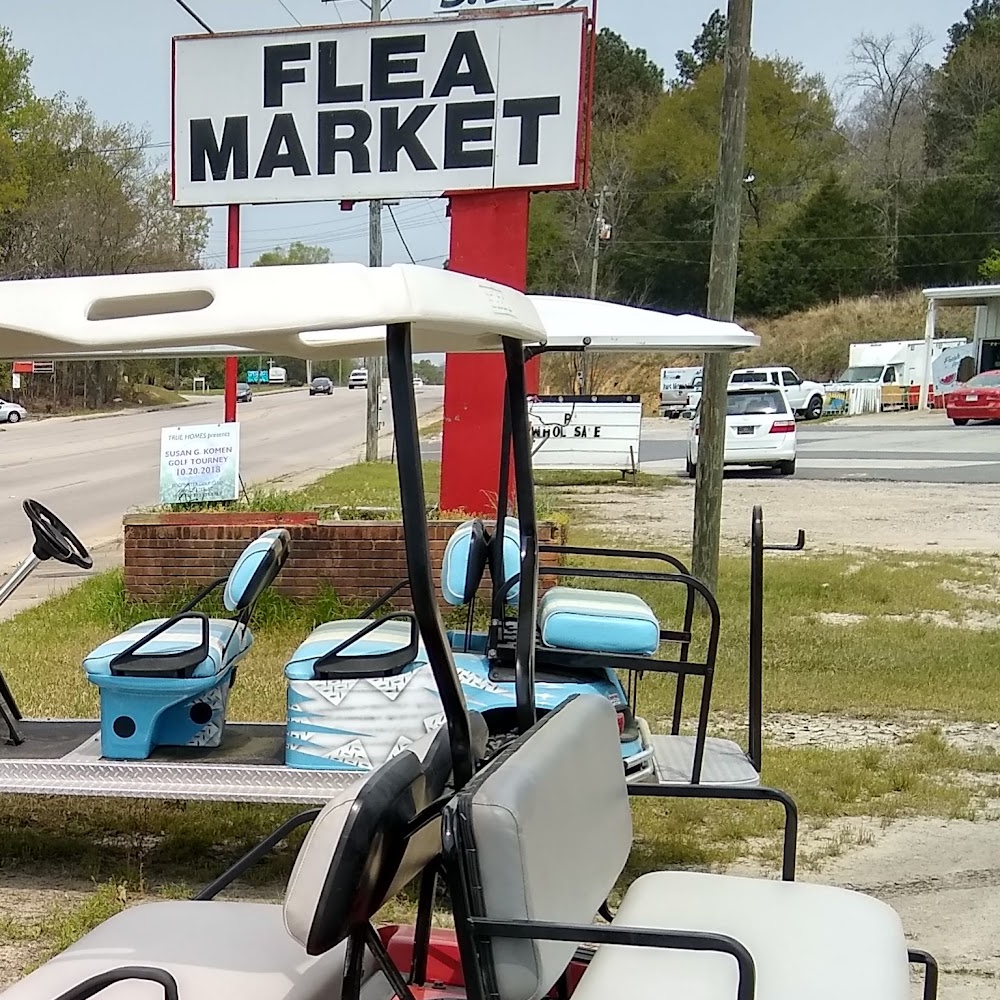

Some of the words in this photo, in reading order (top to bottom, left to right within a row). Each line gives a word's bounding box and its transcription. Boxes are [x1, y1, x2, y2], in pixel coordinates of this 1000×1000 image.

[263, 31, 495, 108] FLEA
[190, 96, 560, 182] MARKET
[165, 449, 192, 457] SUSAN
[203, 447, 232, 455] KOMEN
[191, 456, 228, 465] TOURNEY
[176, 466, 221, 476] 10.20.2018
